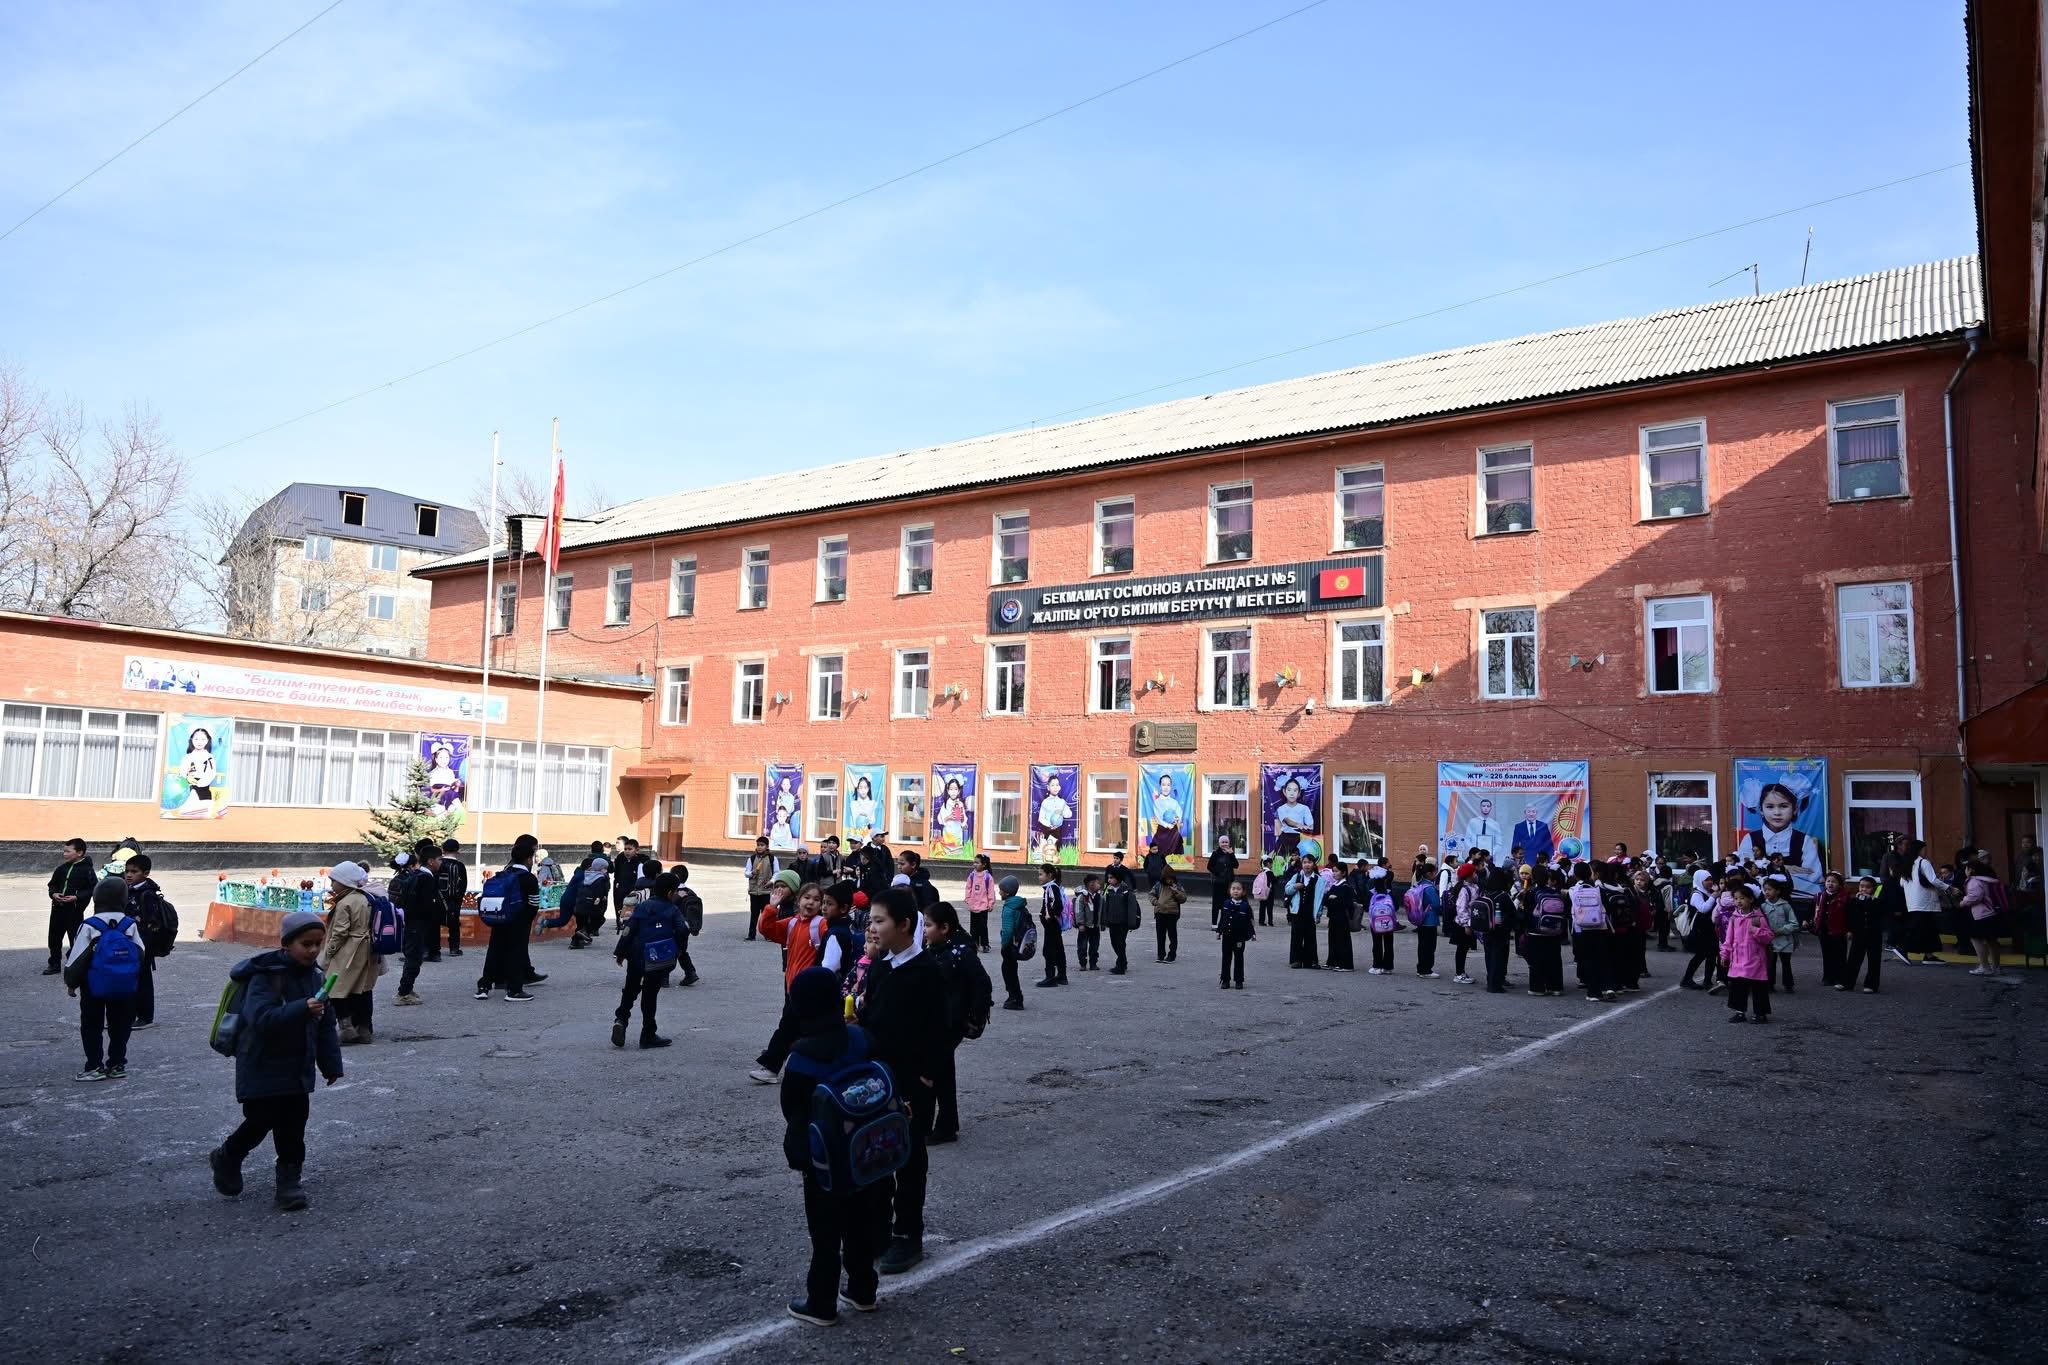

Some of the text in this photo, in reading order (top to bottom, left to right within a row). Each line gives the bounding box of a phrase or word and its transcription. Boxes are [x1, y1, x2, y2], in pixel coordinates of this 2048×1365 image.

[1042, 571, 1296, 605] БЕКМАМАТ ОСМОНОВ АТЫНДАГЫ №5
[1032, 590, 1306, 624] ЖАЛПЫ ОРТО БИЛИМ БЕРҮҮЧҮ МЕКТЕБИ
[202, 683, 285, 699] жоголбос
[289, 690, 350, 706] байлык,
[355, 698, 414, 711] кемибес
[1504, 773, 1538, 781] баллдын
